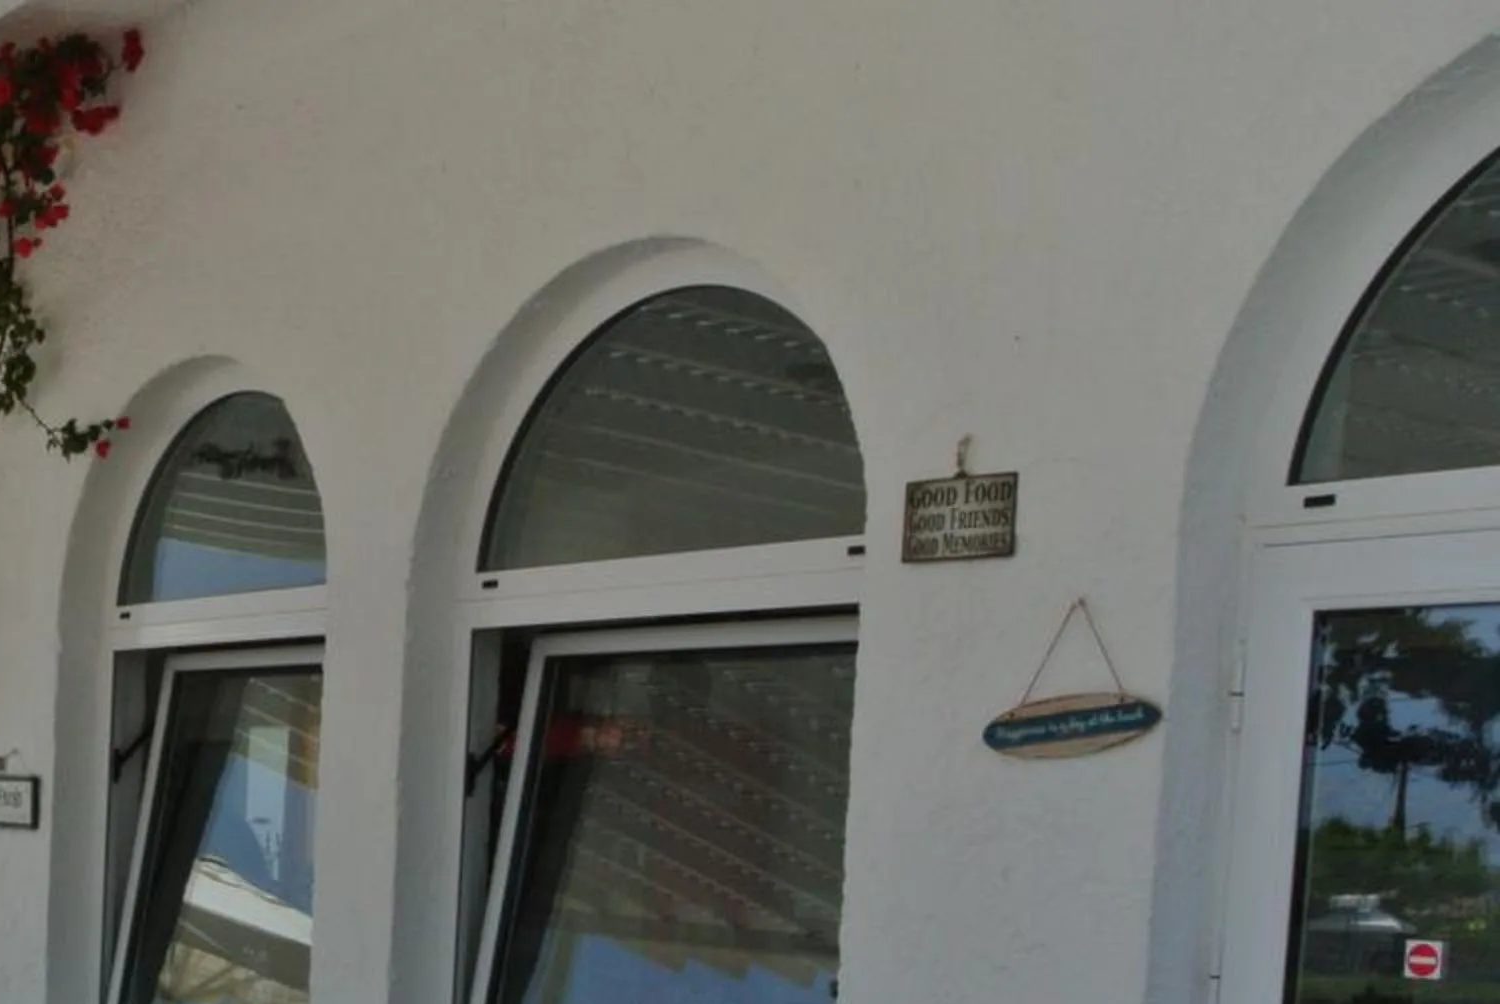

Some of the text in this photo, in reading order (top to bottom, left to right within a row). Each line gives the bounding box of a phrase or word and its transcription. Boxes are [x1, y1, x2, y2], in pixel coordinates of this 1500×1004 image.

[910, 480, 1012, 509] GOOD FOOD
[909, 508, 1010, 533] GOOD FRIENDS
